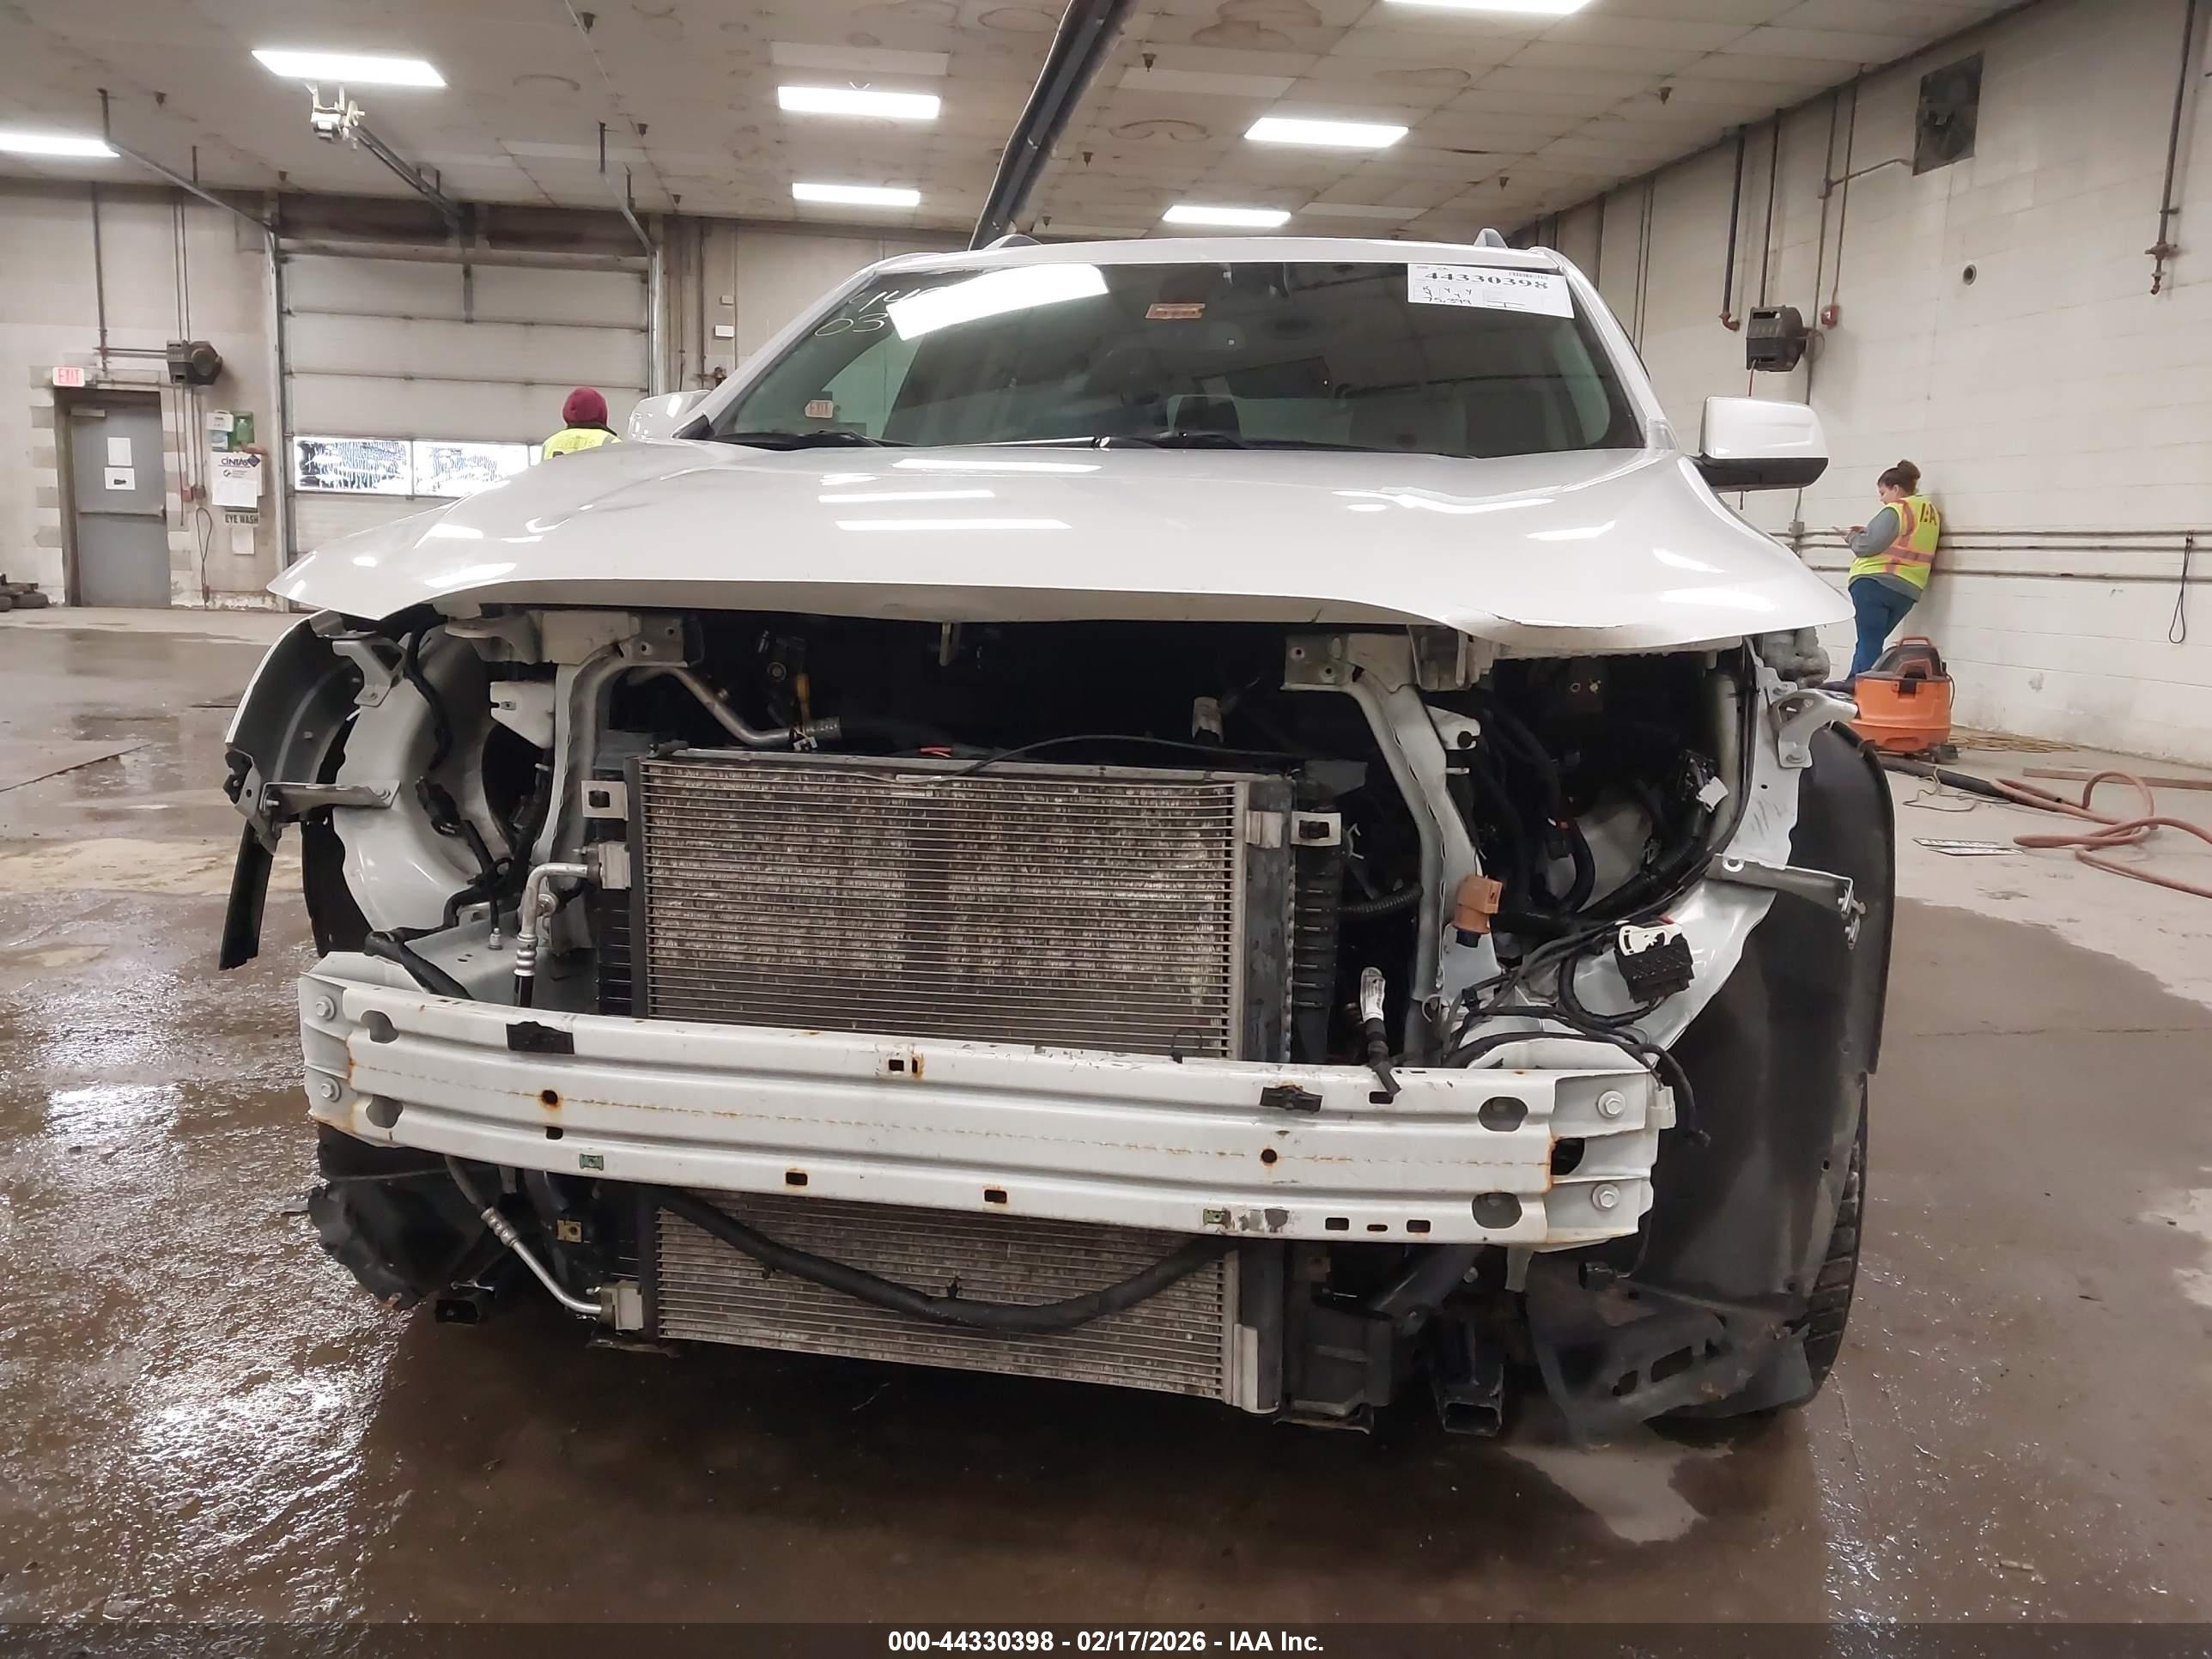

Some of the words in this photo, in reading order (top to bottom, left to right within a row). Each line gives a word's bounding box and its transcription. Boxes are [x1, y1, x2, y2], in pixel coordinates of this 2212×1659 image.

[1425, 272, 1548, 289] 44330398
[58, 368, 81, 385] EXIT
[225, 514, 238, 524] EYE
[240, 515, 258, 525] WASH
